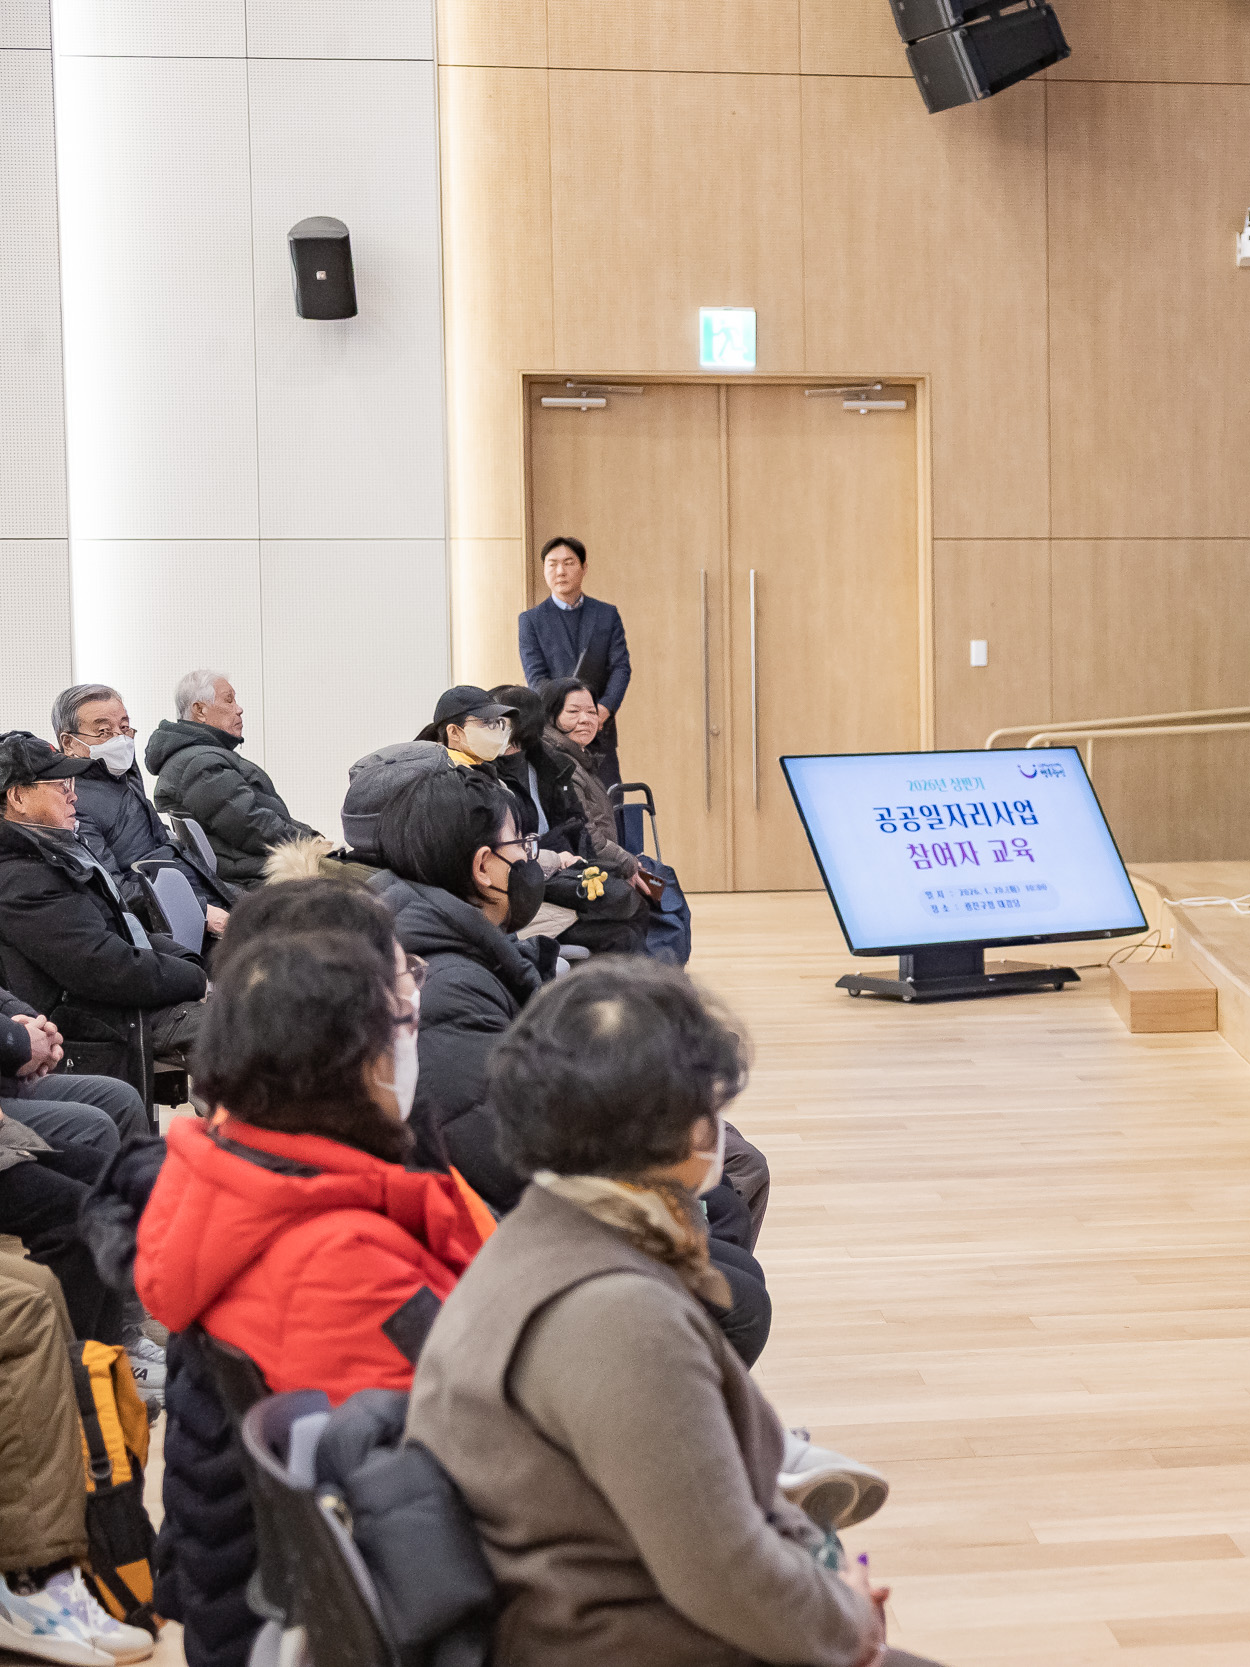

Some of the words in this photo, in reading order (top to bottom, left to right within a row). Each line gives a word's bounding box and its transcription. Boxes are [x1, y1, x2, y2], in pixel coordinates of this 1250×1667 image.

[906, 778, 949, 792] 2026년
[949, 776, 985, 792] 상반기
[872, 799, 1039, 834] 공공일자리사업
[906, 840, 981, 870] 참여자
[987, 837, 1035, 863] 교육
